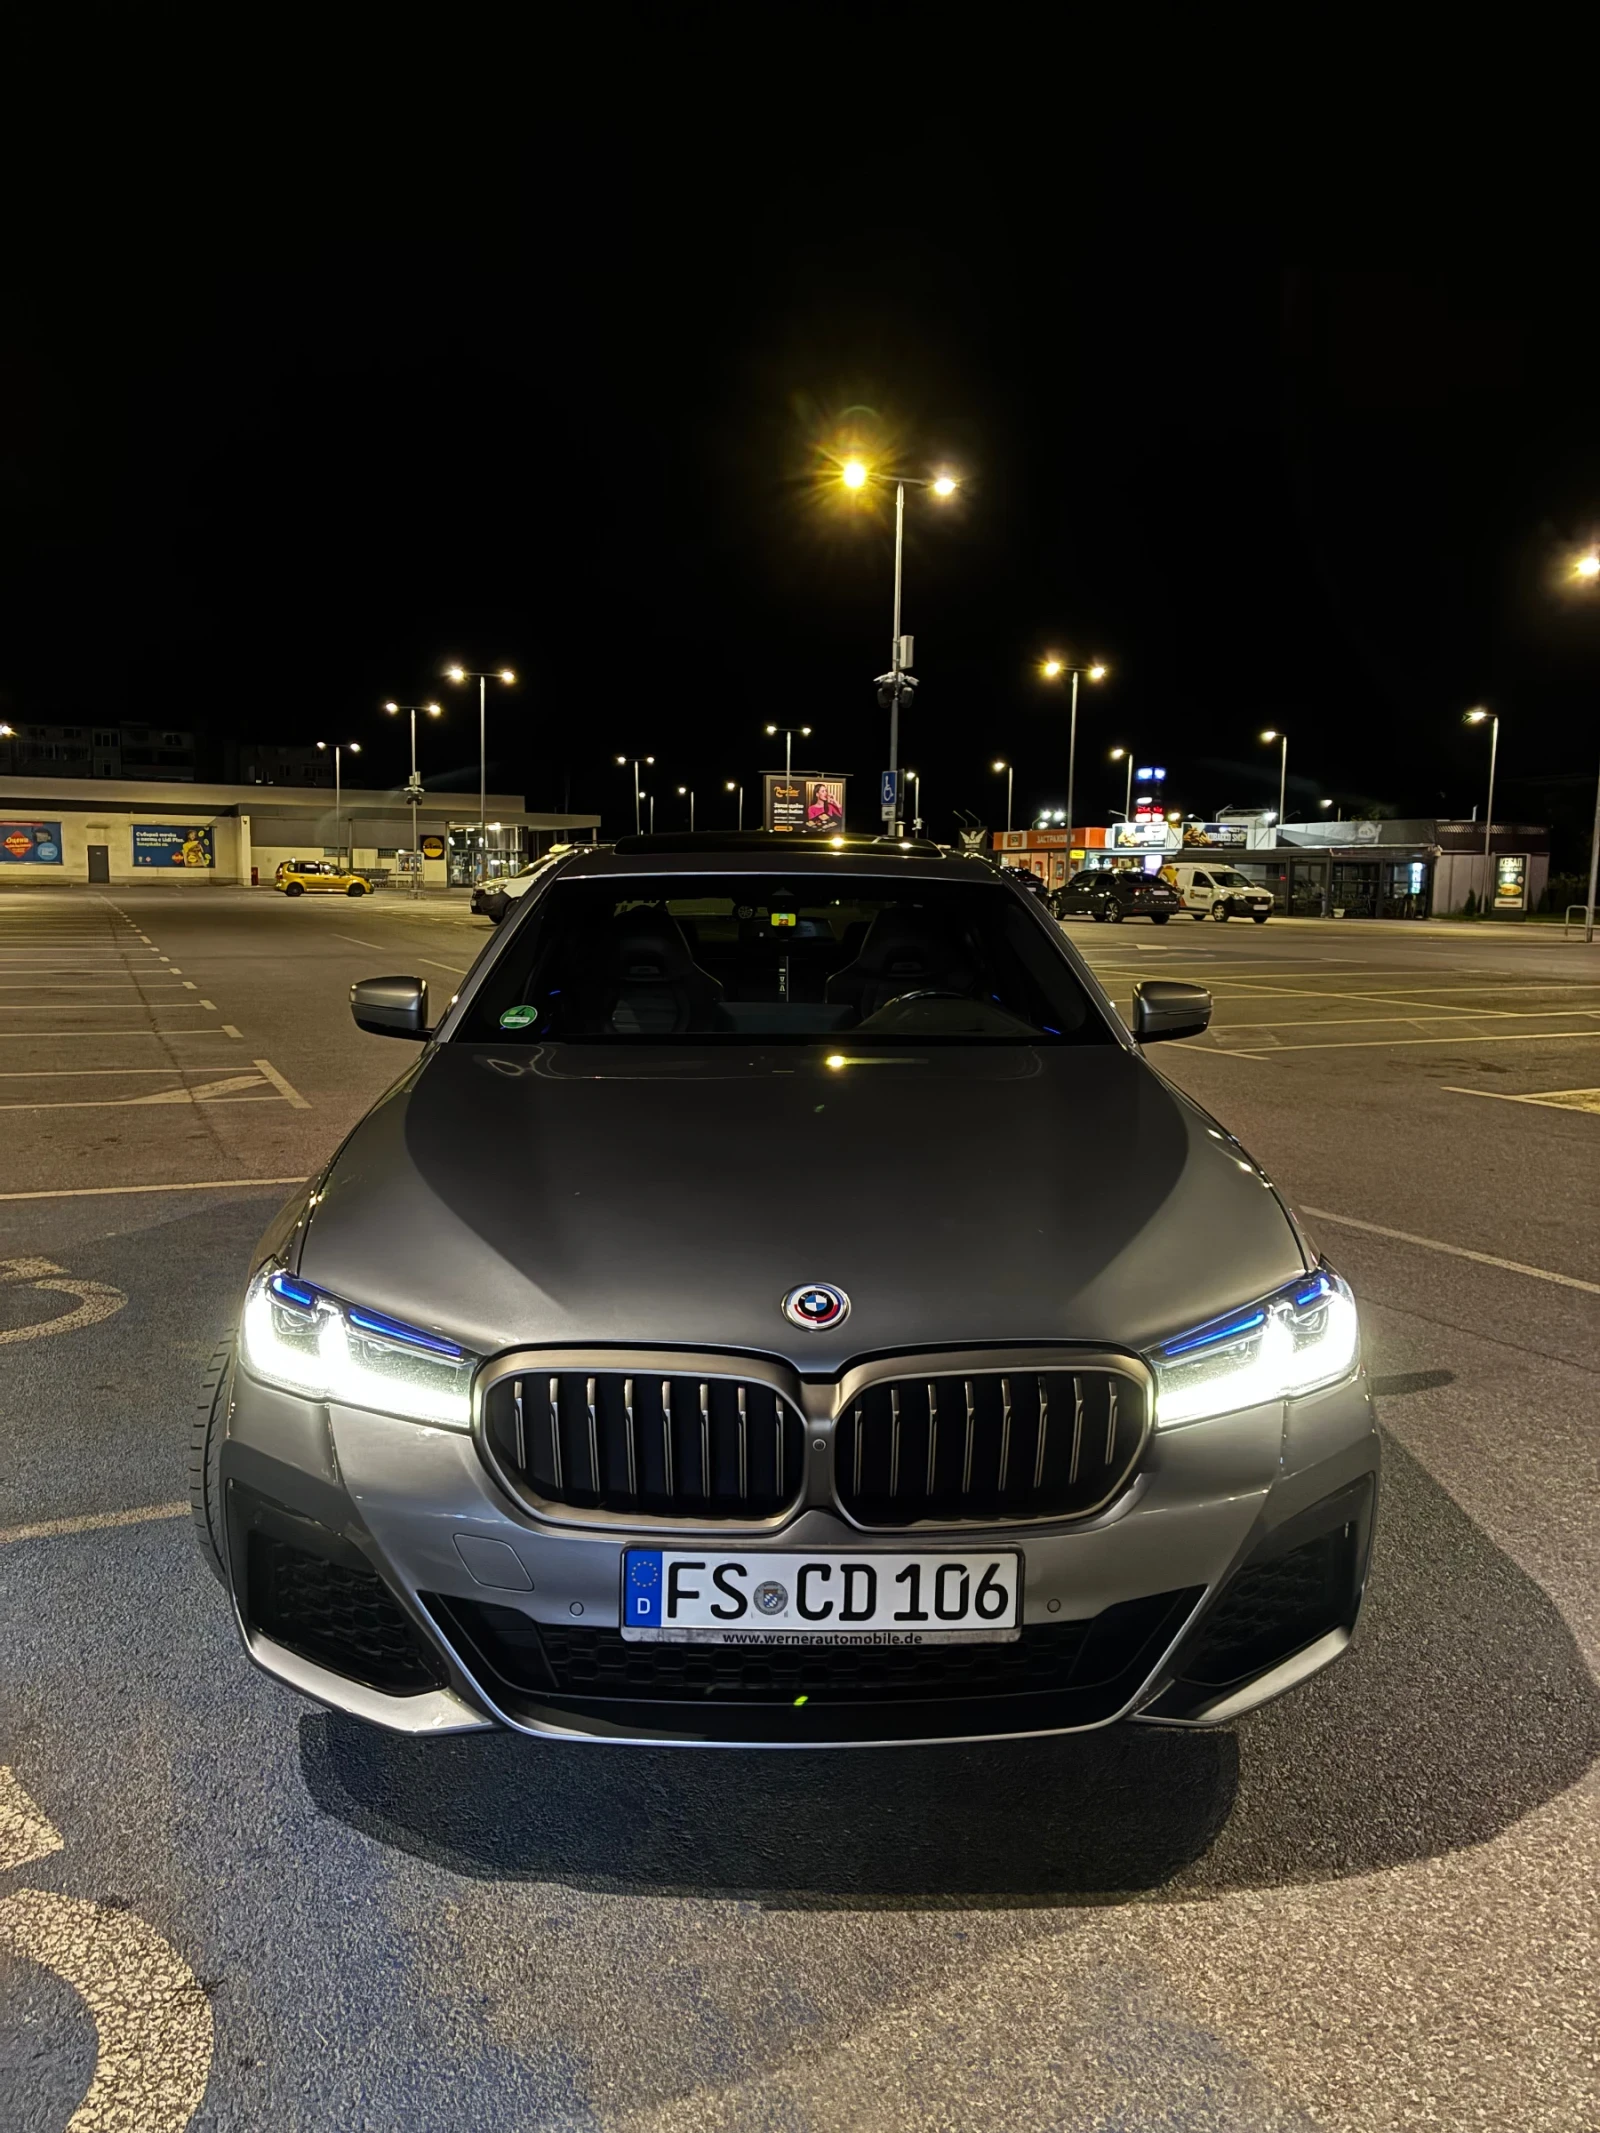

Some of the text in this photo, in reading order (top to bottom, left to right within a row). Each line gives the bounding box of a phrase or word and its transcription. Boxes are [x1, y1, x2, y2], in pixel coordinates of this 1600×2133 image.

[1036, 834, 1076, 844] ЗАСТРАХОВИ
[515, 1007, 527, 1017] 4
[667, 1562, 749, 1620] FS
[797, 1563, 877, 1621] CD
[894, 1563, 1009, 1621] 106
[637, 1598, 651, 1614] D
[723, 1631, 923, 1646] www.wernerautomobile.de
